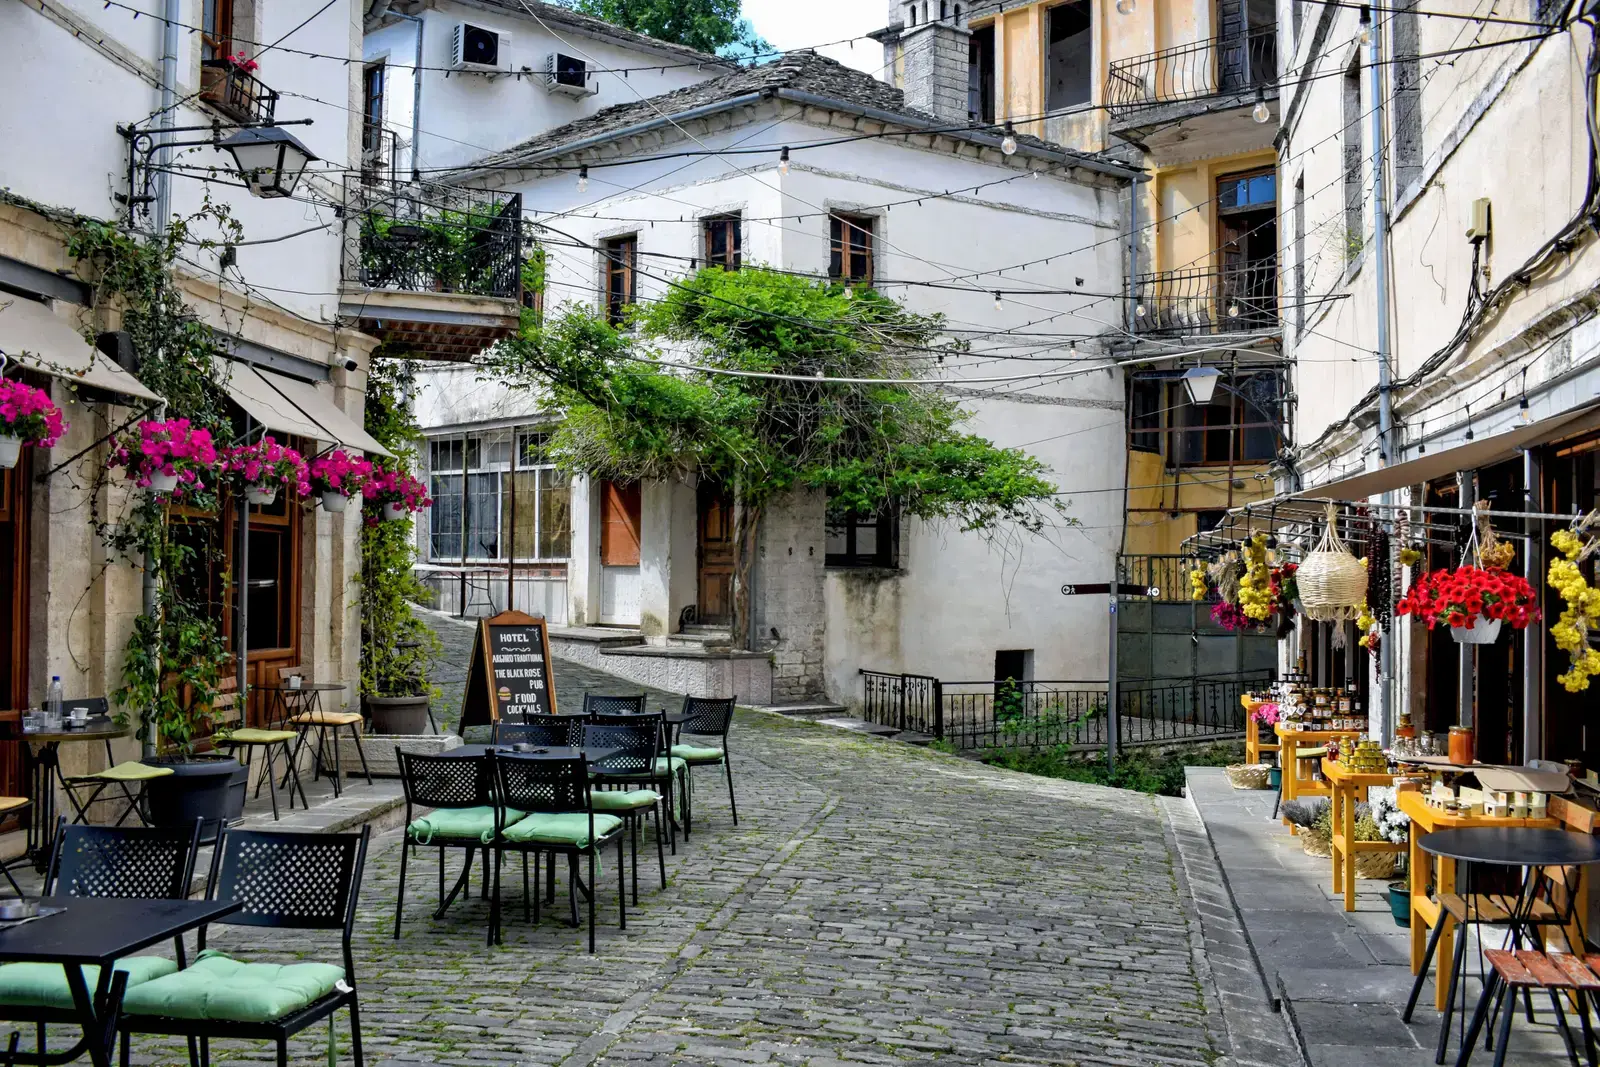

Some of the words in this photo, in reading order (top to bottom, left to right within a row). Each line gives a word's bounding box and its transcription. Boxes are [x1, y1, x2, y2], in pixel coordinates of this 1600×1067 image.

[500, 633, 529, 642] HOTEL
[514, 654, 543, 662] TRADITIONAL
[495, 669, 506, 678] THE
[506, 668, 525, 678] BLACK
[524, 668, 541, 678] ROSE
[529, 679, 544, 689] PUB
[515, 693, 537, 704] FOOD
